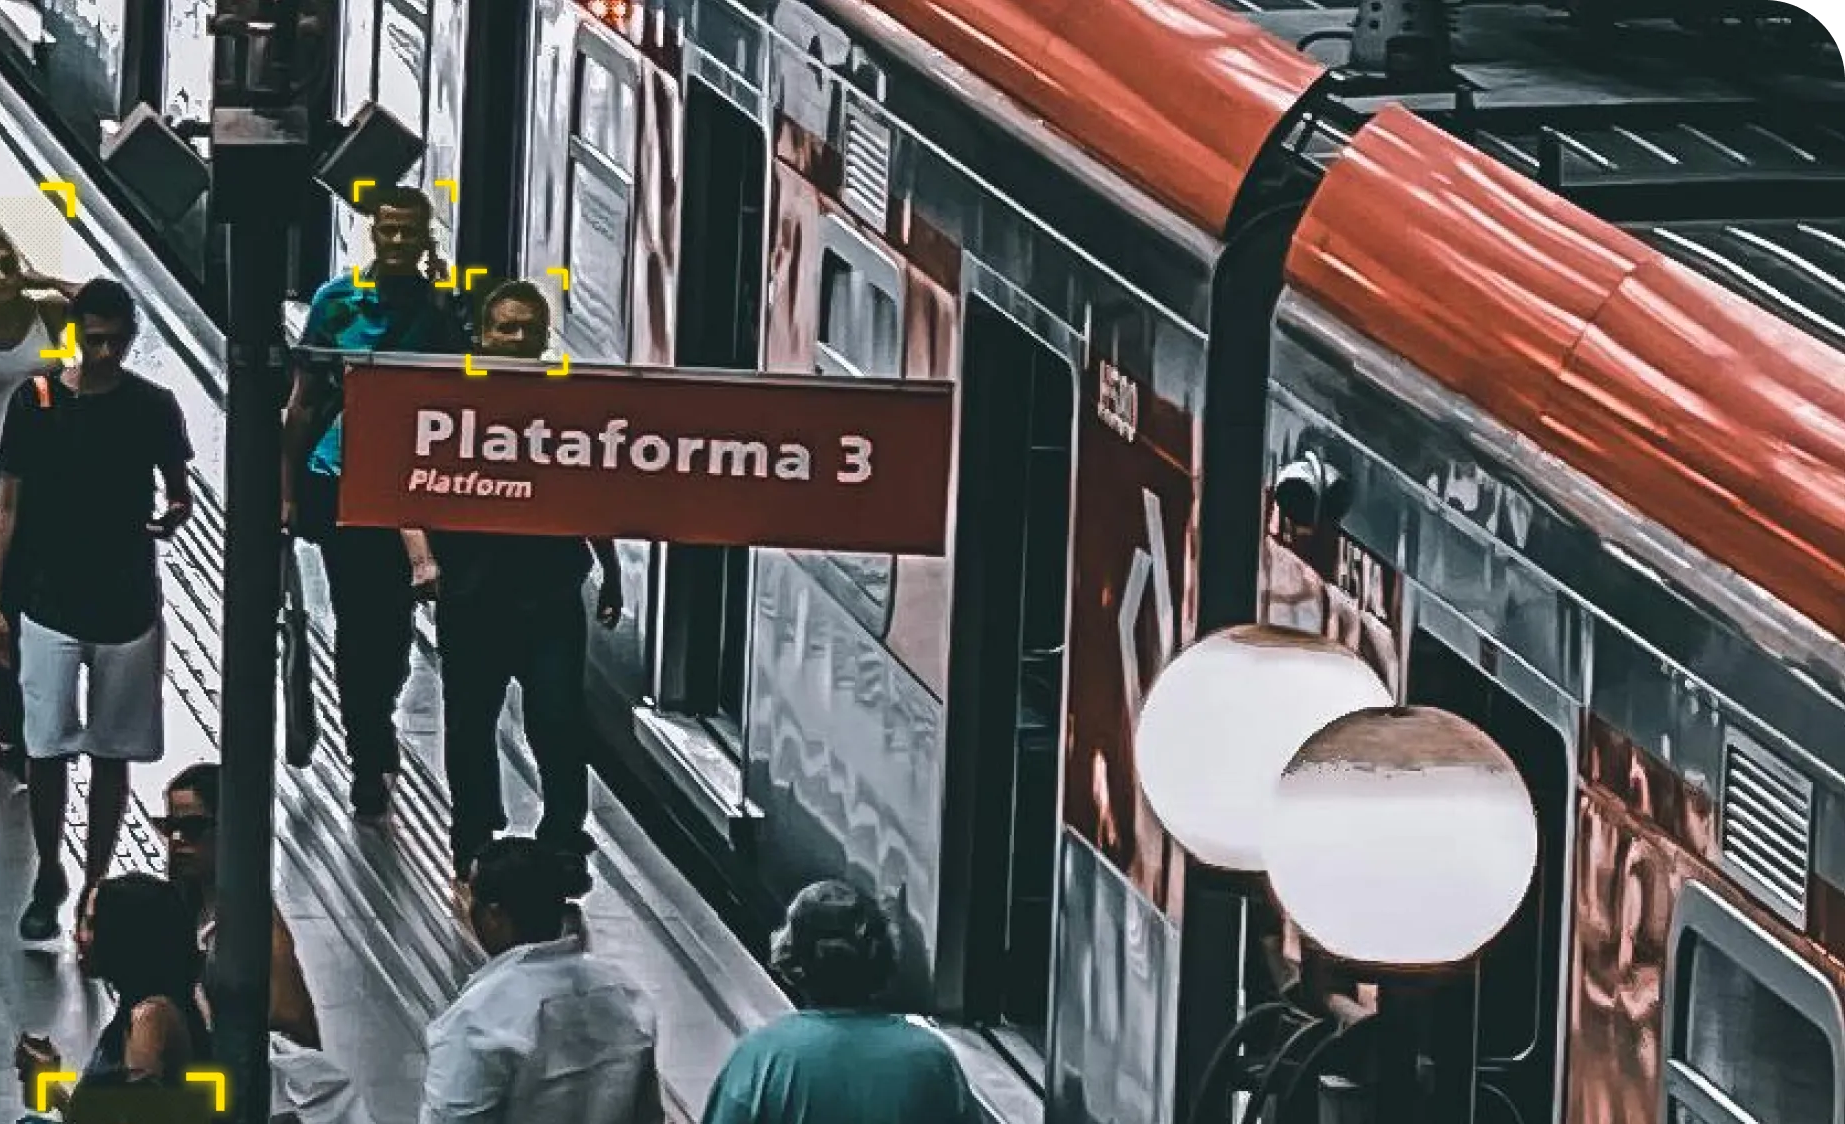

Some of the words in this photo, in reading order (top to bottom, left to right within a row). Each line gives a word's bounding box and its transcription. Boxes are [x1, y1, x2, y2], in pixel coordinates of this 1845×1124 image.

[414, 409, 811, 481] Plataforma
[836, 434, 873, 484] 3
[408, 467, 532, 498] Platform
